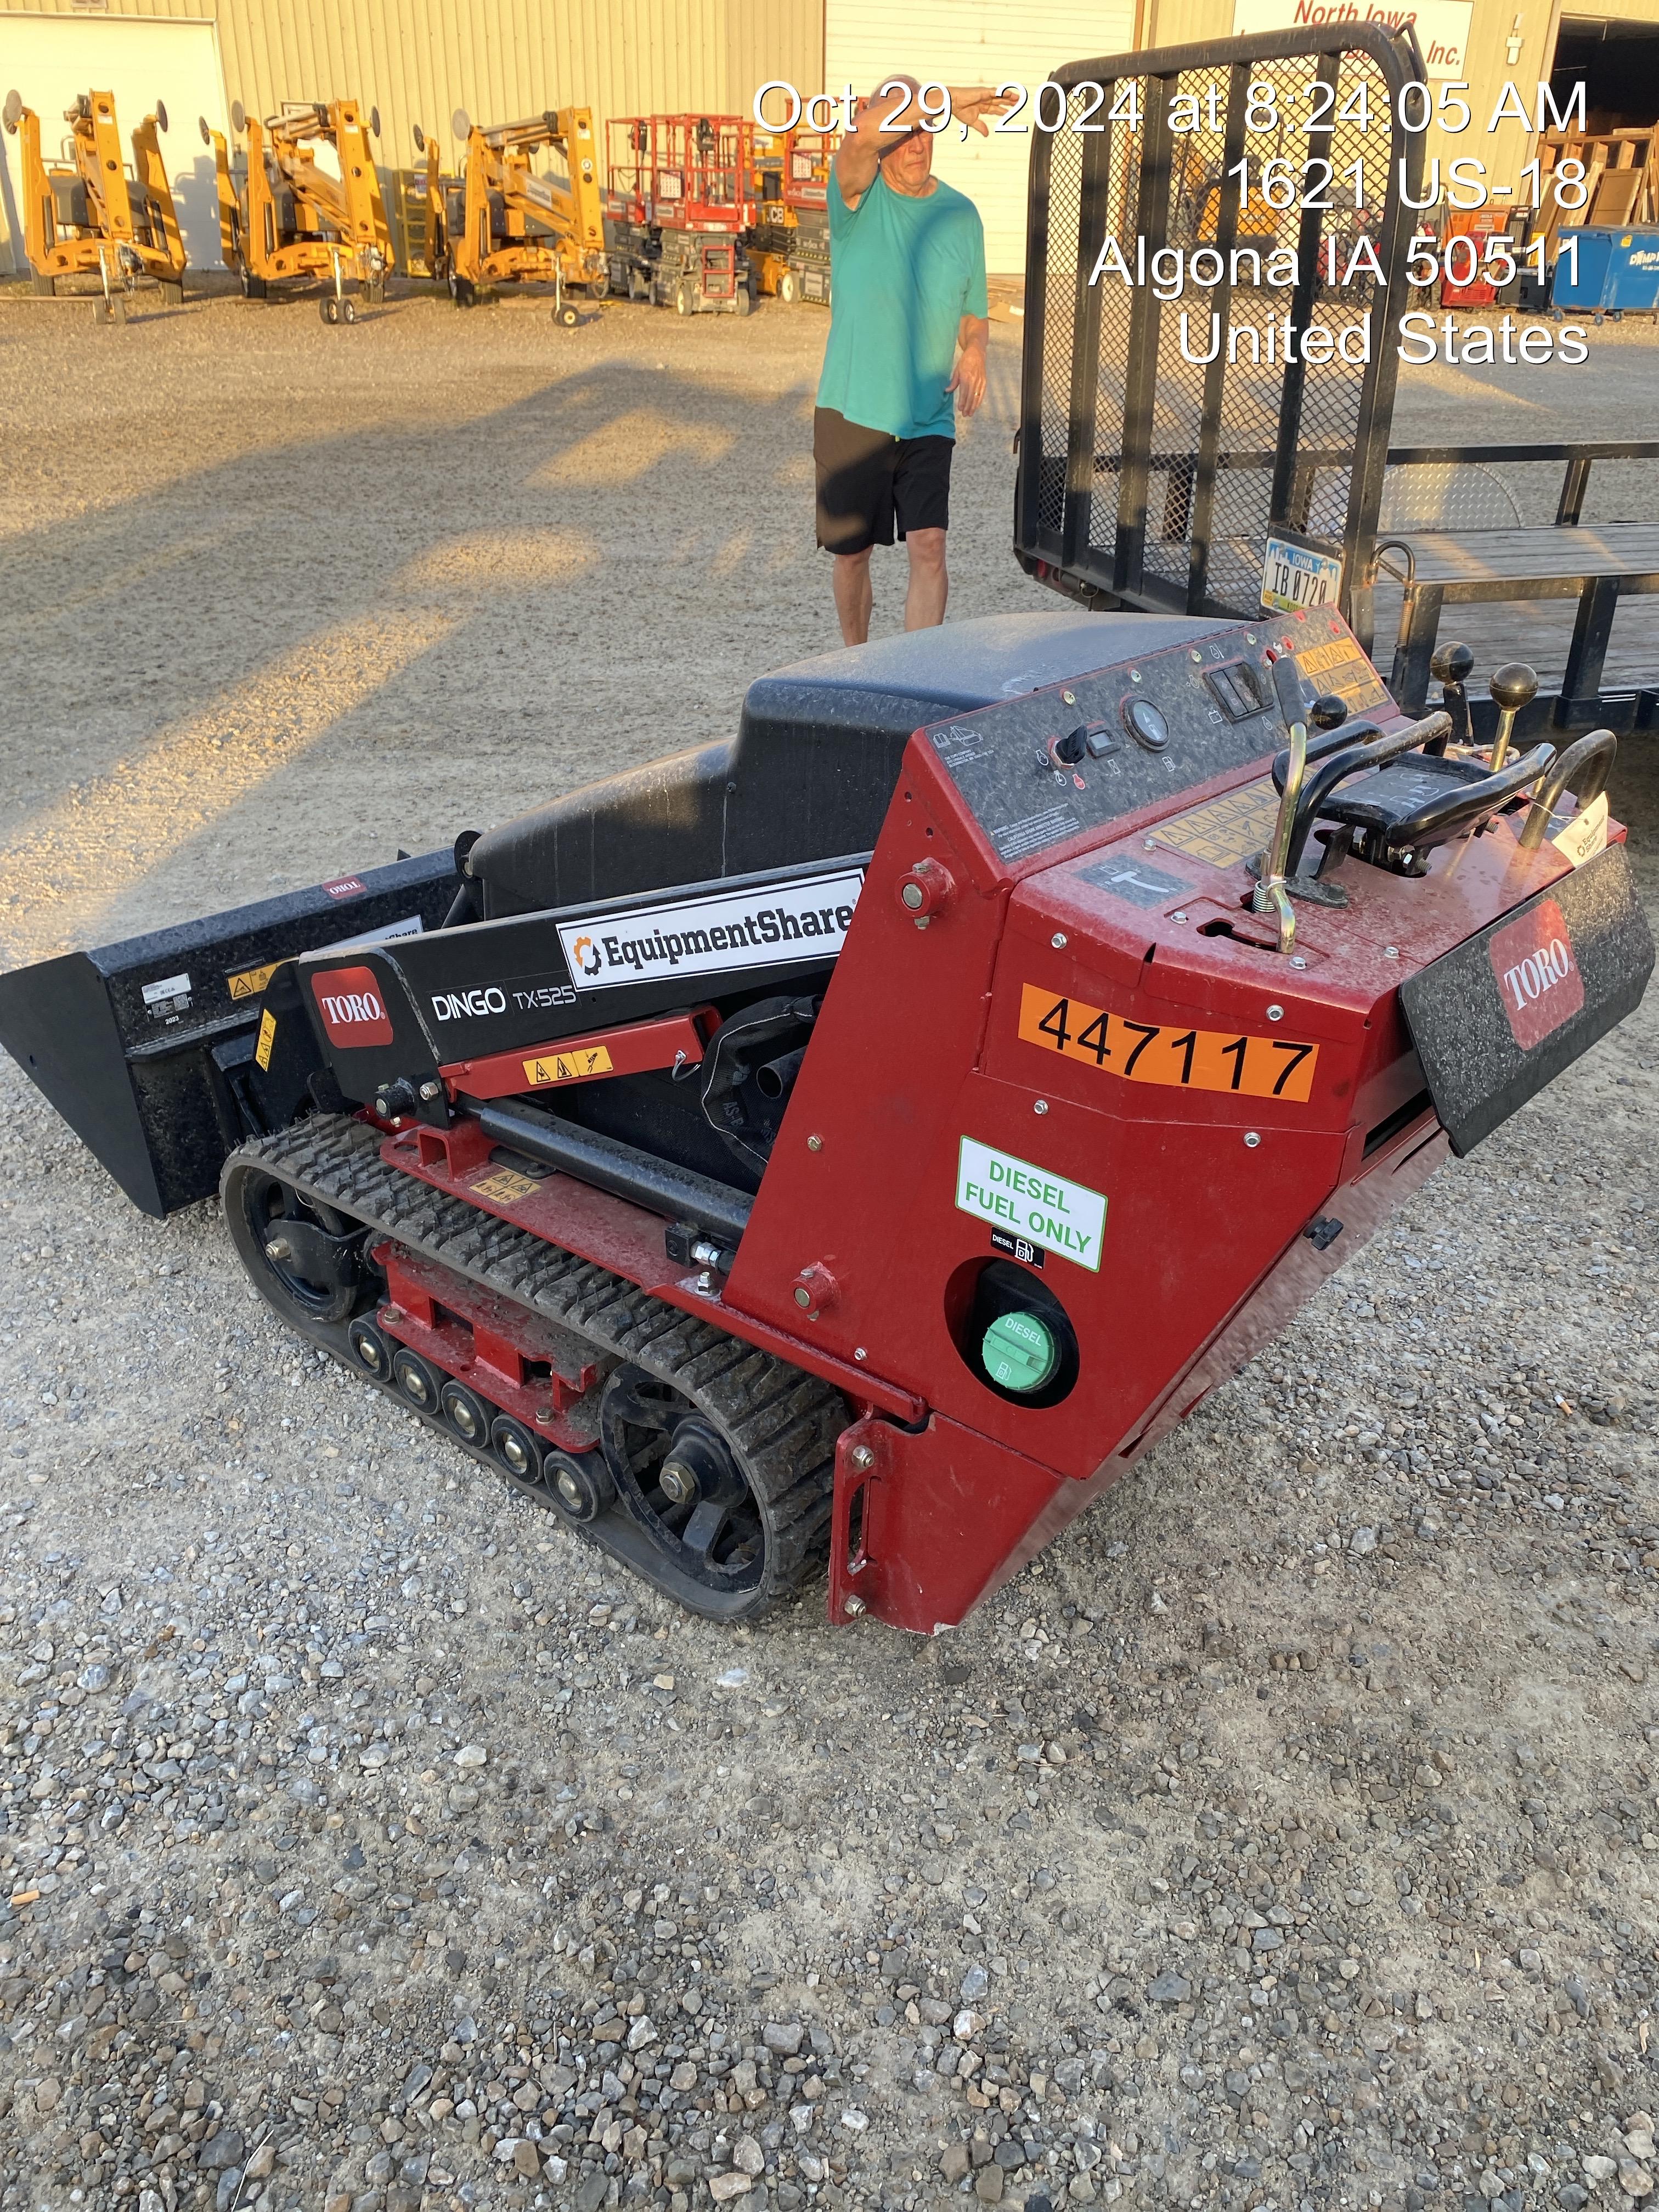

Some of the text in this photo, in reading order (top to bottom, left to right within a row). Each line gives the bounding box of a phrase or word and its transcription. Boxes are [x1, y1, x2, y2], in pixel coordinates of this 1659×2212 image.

[1293, 0, 1417, 26] North Iowa
[1426, 40, 1460, 65] Inc.
[1293, 552, 1313, 571] IOWA
[329, 881, 361, 895] TORO
[601, 905, 854, 970] EquipmentShare
[1503, 938, 1568, 1011] TORO
[321, 992, 380, 1024] TORO
[432, 987, 506, 1021] DINGO
[165, 1015, 179, 1025] 2023
[1038, 998, 1313, 1096] 447117
[990, 1160, 1070, 1214] DIESEL
[966, 1182, 1092, 1254] FUEL ONLY
[992, 1234, 1014, 1250] DIESEL
[1005, 1318, 1041, 1346] DIESEL
